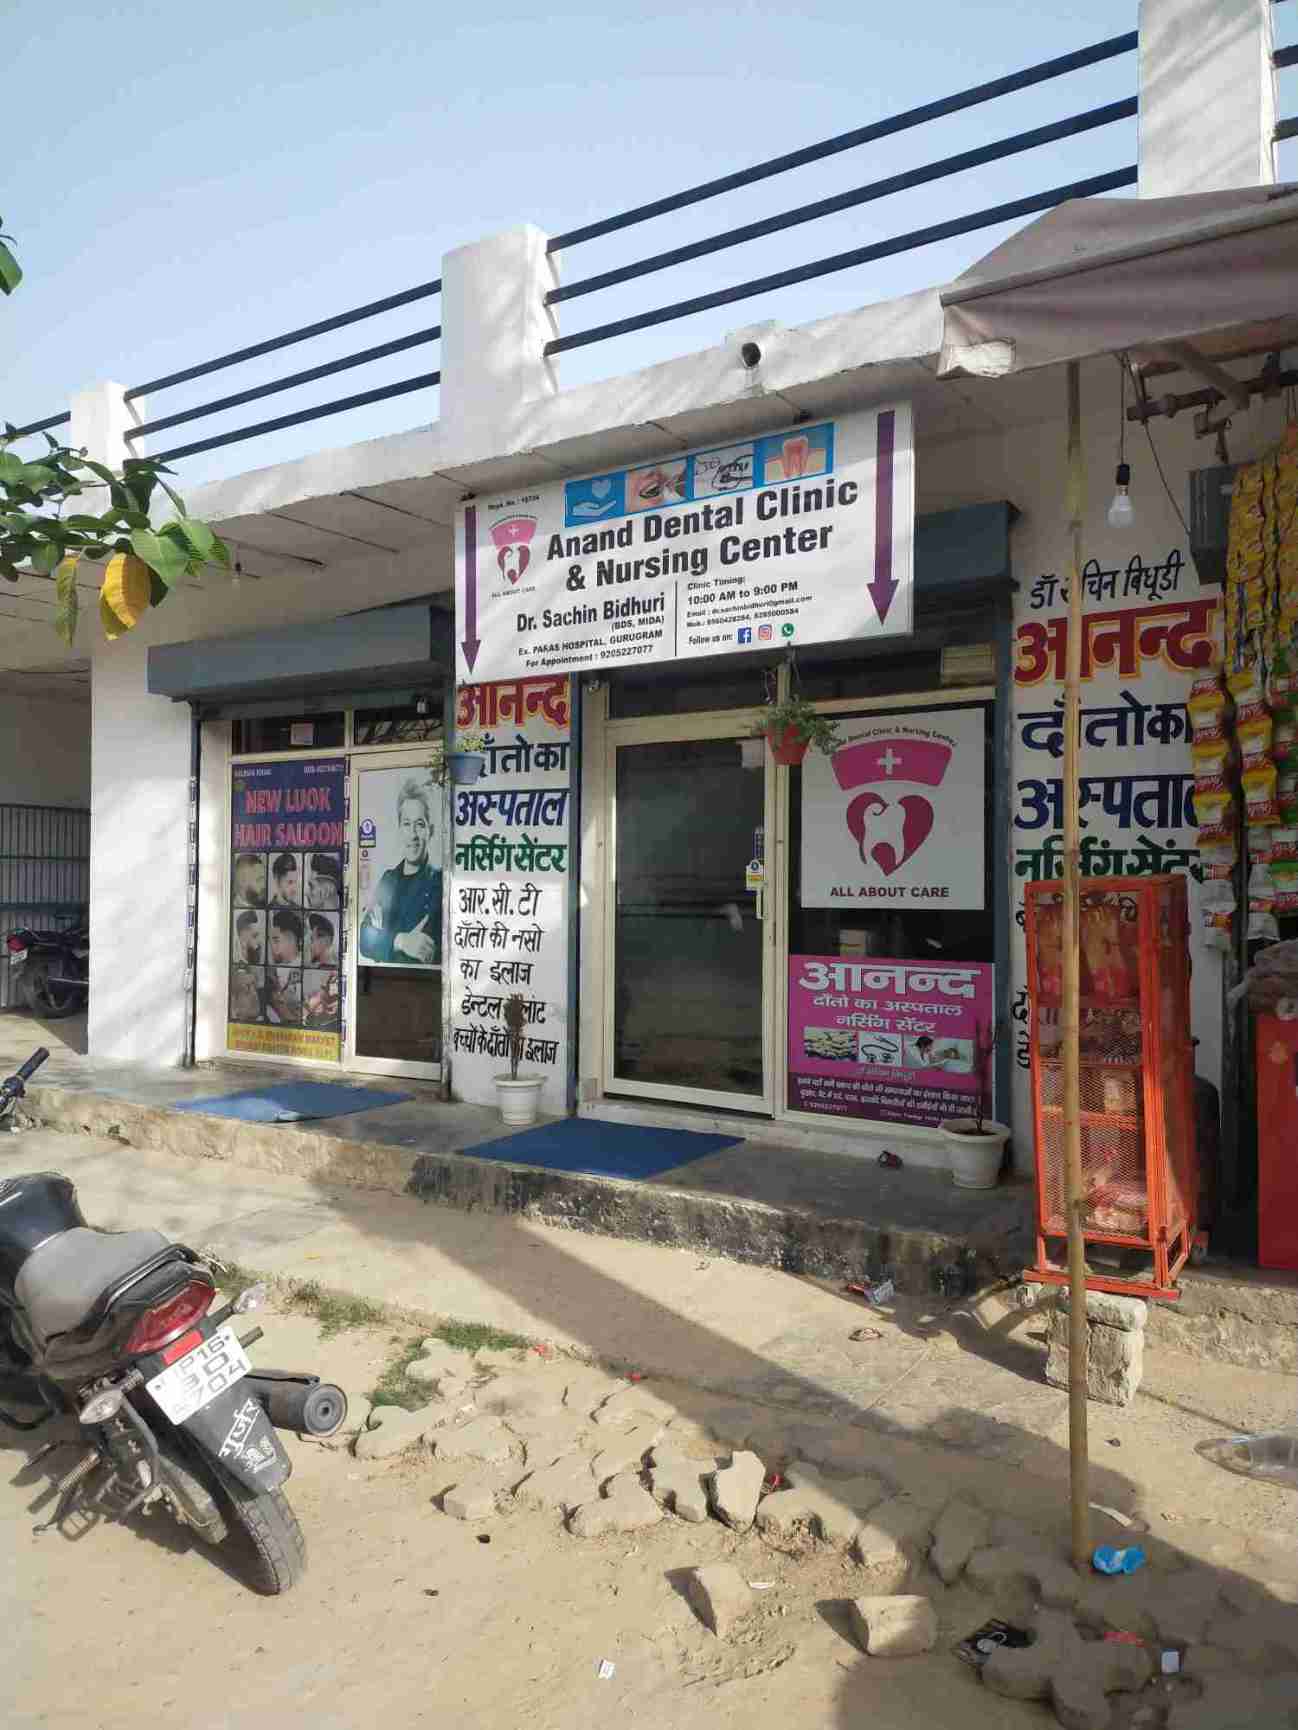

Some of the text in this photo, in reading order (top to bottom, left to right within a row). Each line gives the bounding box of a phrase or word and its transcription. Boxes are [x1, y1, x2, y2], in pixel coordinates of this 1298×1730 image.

[547, 479, 858, 560] Anand Dental Clinic
[566, 522, 834, 592] & Nursing Center
[688, 581, 711, 590] Clinic
[688, 581, 798, 605] 10:00 AM to 9:00 PM
[517, 592, 664, 632] Dr. Sachin Bidhuri
[610, 629, 663, 644] GURUGRAM
[1014, 597, 1220, 687] आनन्द
[541, 653, 592, 666] Appointment
[457, 674, 571, 728] आनन्द
[245, 789, 282, 814] NEW
[456, 788, 570, 826] अस्पताल
[275, 822, 343, 848] SALOON
[830, 887, 950, 898] ALL ABOUT CARE
[460, 959, 534, 984] का इलाज
[800, 962, 981, 999] आनन्द
[854, 998, 879, 1010] का
[526, 1037, 560, 1064] इलाज
